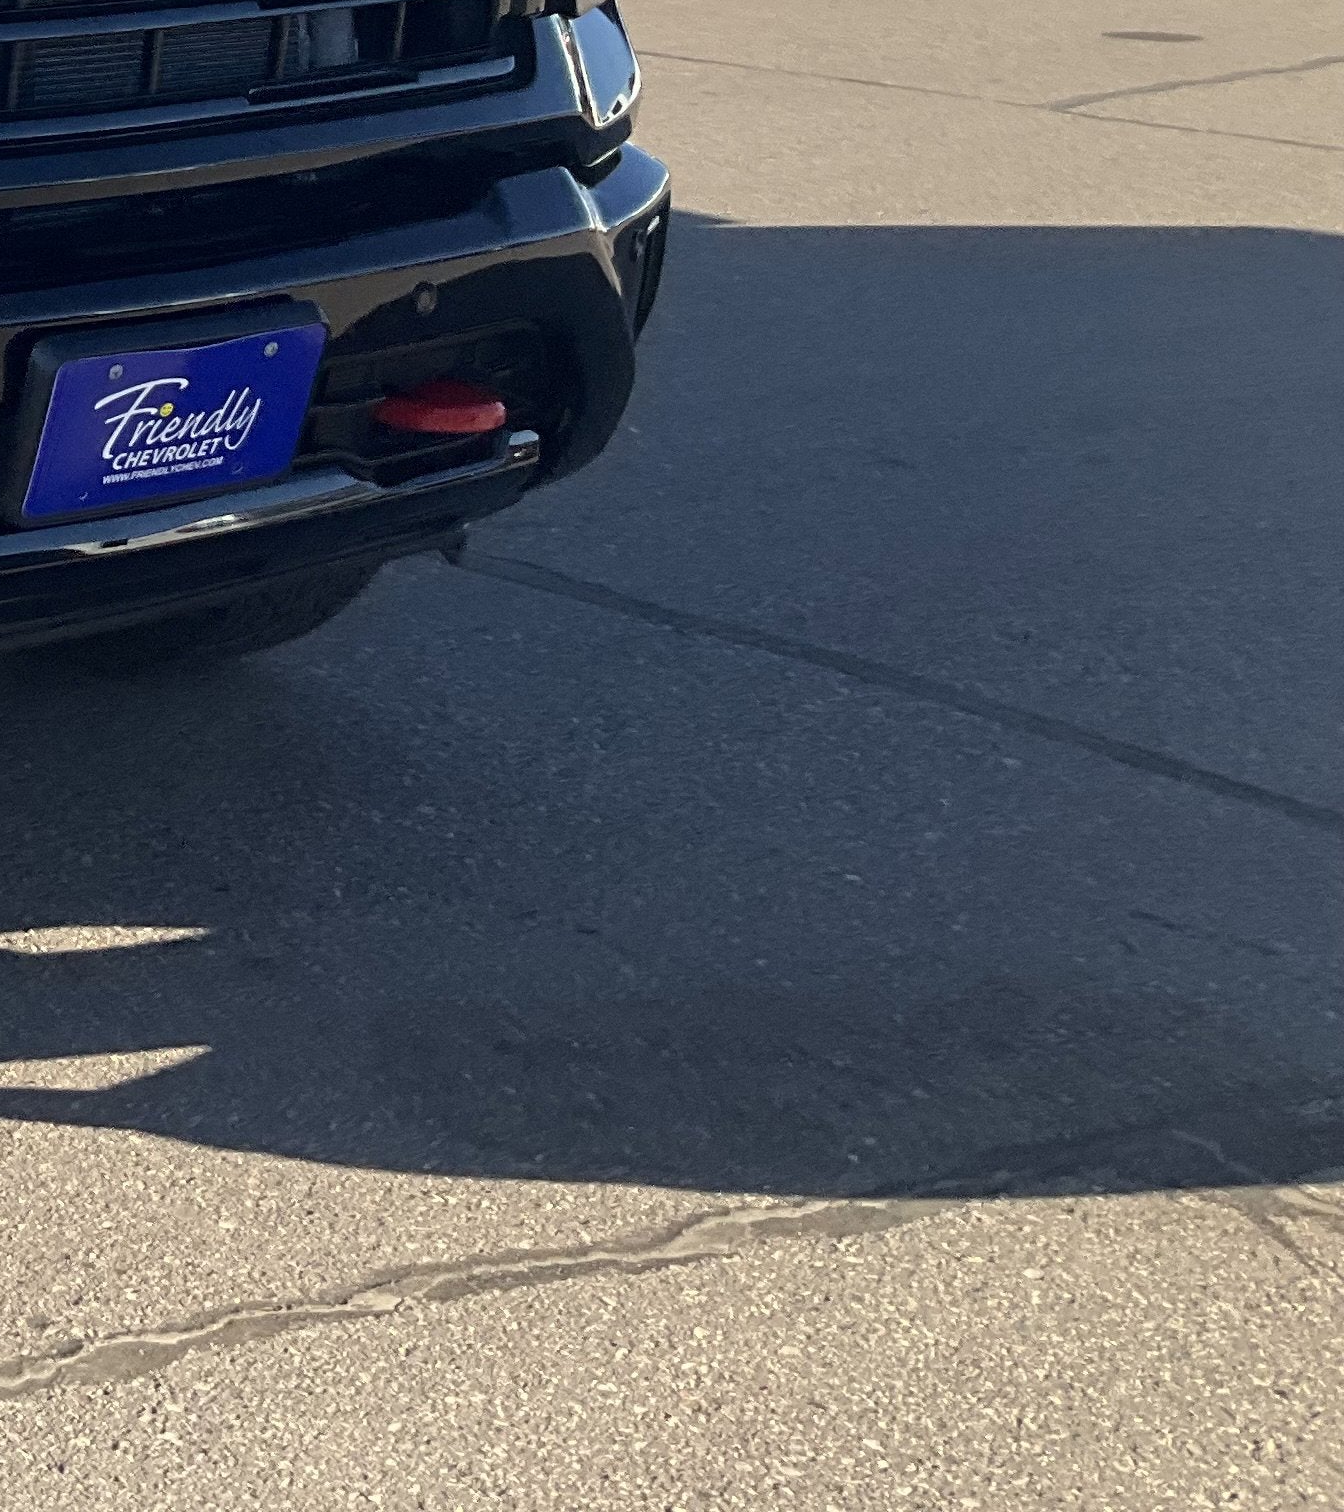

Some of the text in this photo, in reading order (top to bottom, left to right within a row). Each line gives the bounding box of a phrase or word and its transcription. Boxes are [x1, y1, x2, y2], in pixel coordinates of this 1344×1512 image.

[94, 377, 262, 459] Friendly
[102, 455, 224, 485] WWW.FRIENDLYCHEV.COM
[112, 437, 223, 471] CHEVROLET
